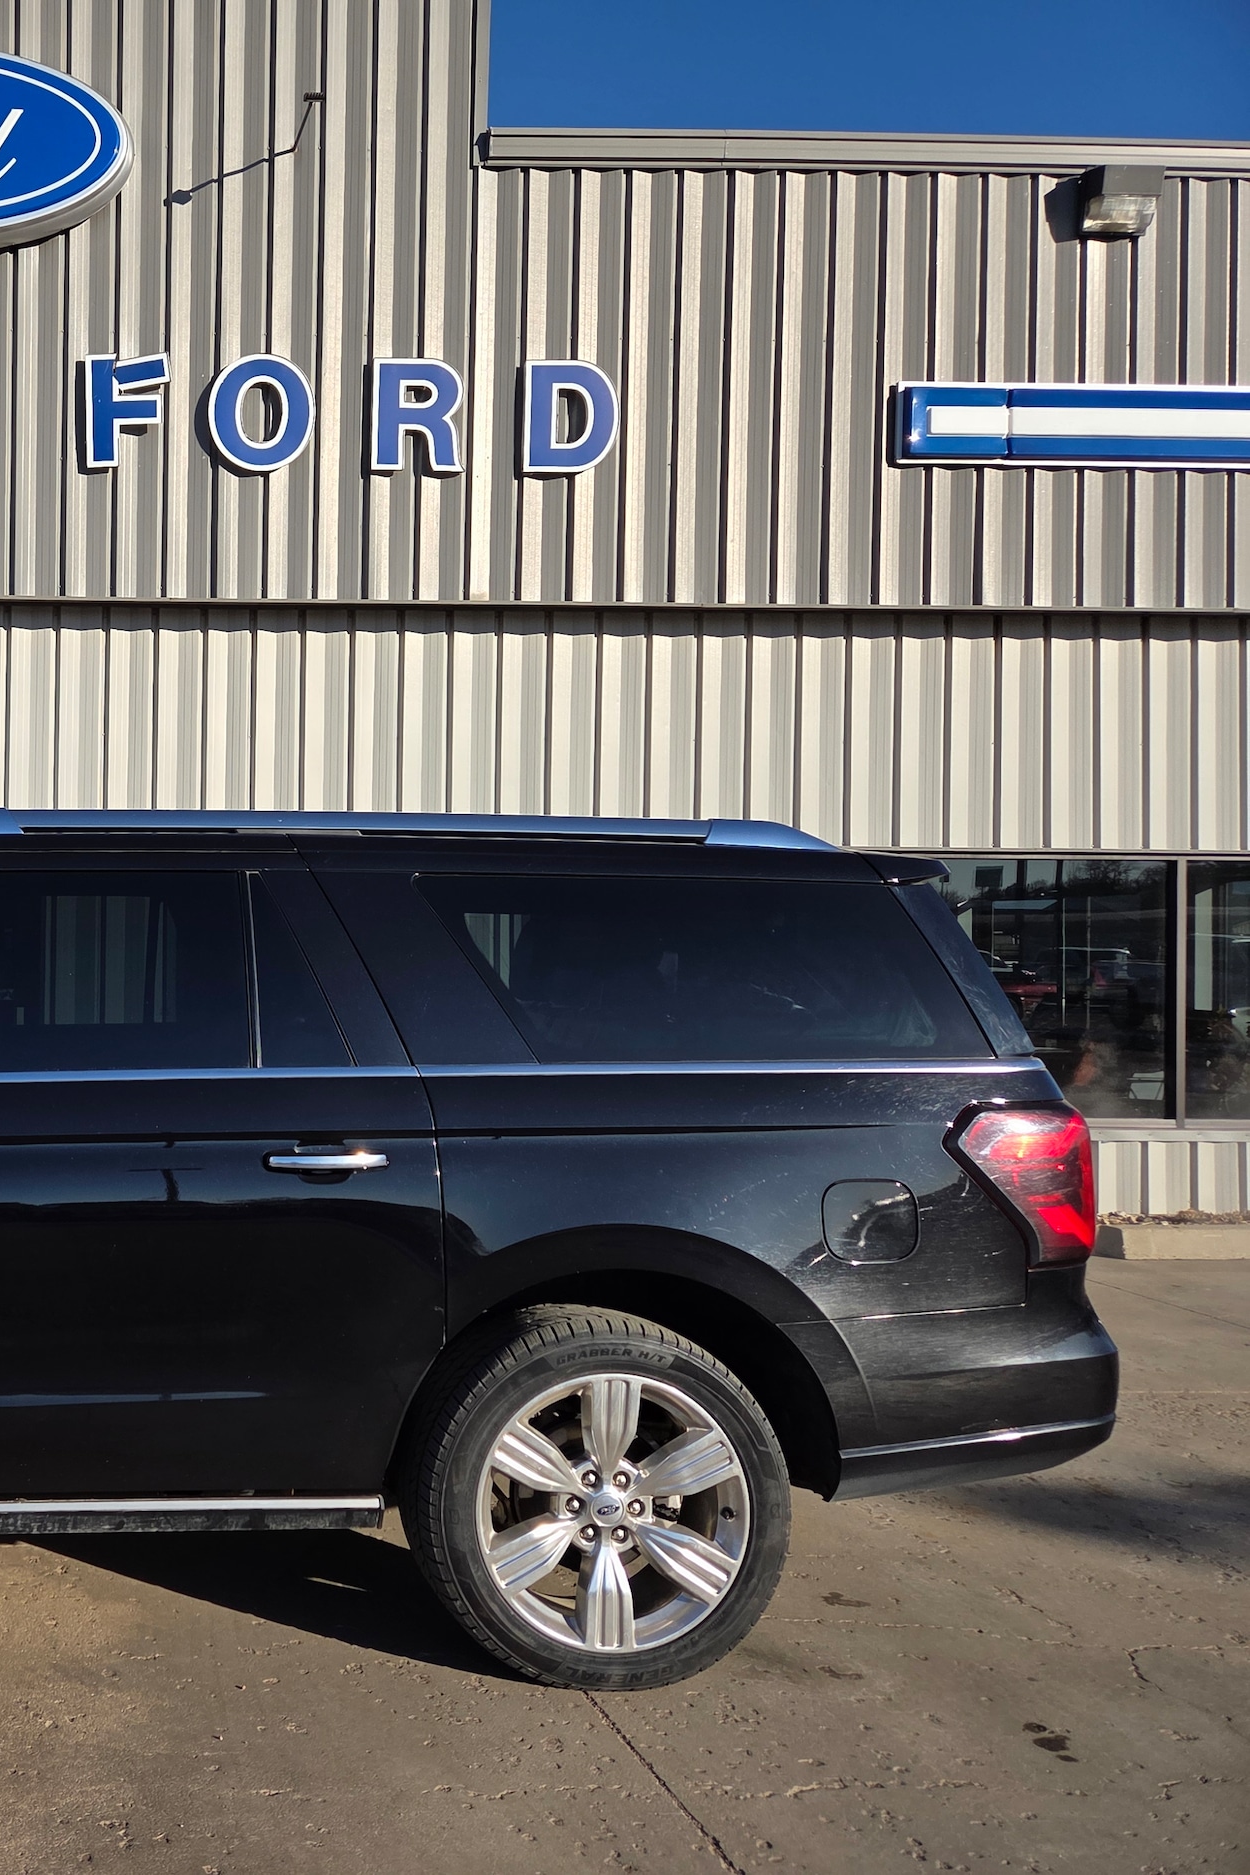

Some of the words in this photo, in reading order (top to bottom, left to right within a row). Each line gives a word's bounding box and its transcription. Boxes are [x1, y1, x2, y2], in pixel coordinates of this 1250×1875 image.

[84, 352, 620, 473] FORD
[556, 1347, 633, 1366] GRABBER
[638, 1351, 667, 1363] H/T
[565, 1663, 676, 1685] GENERAL
